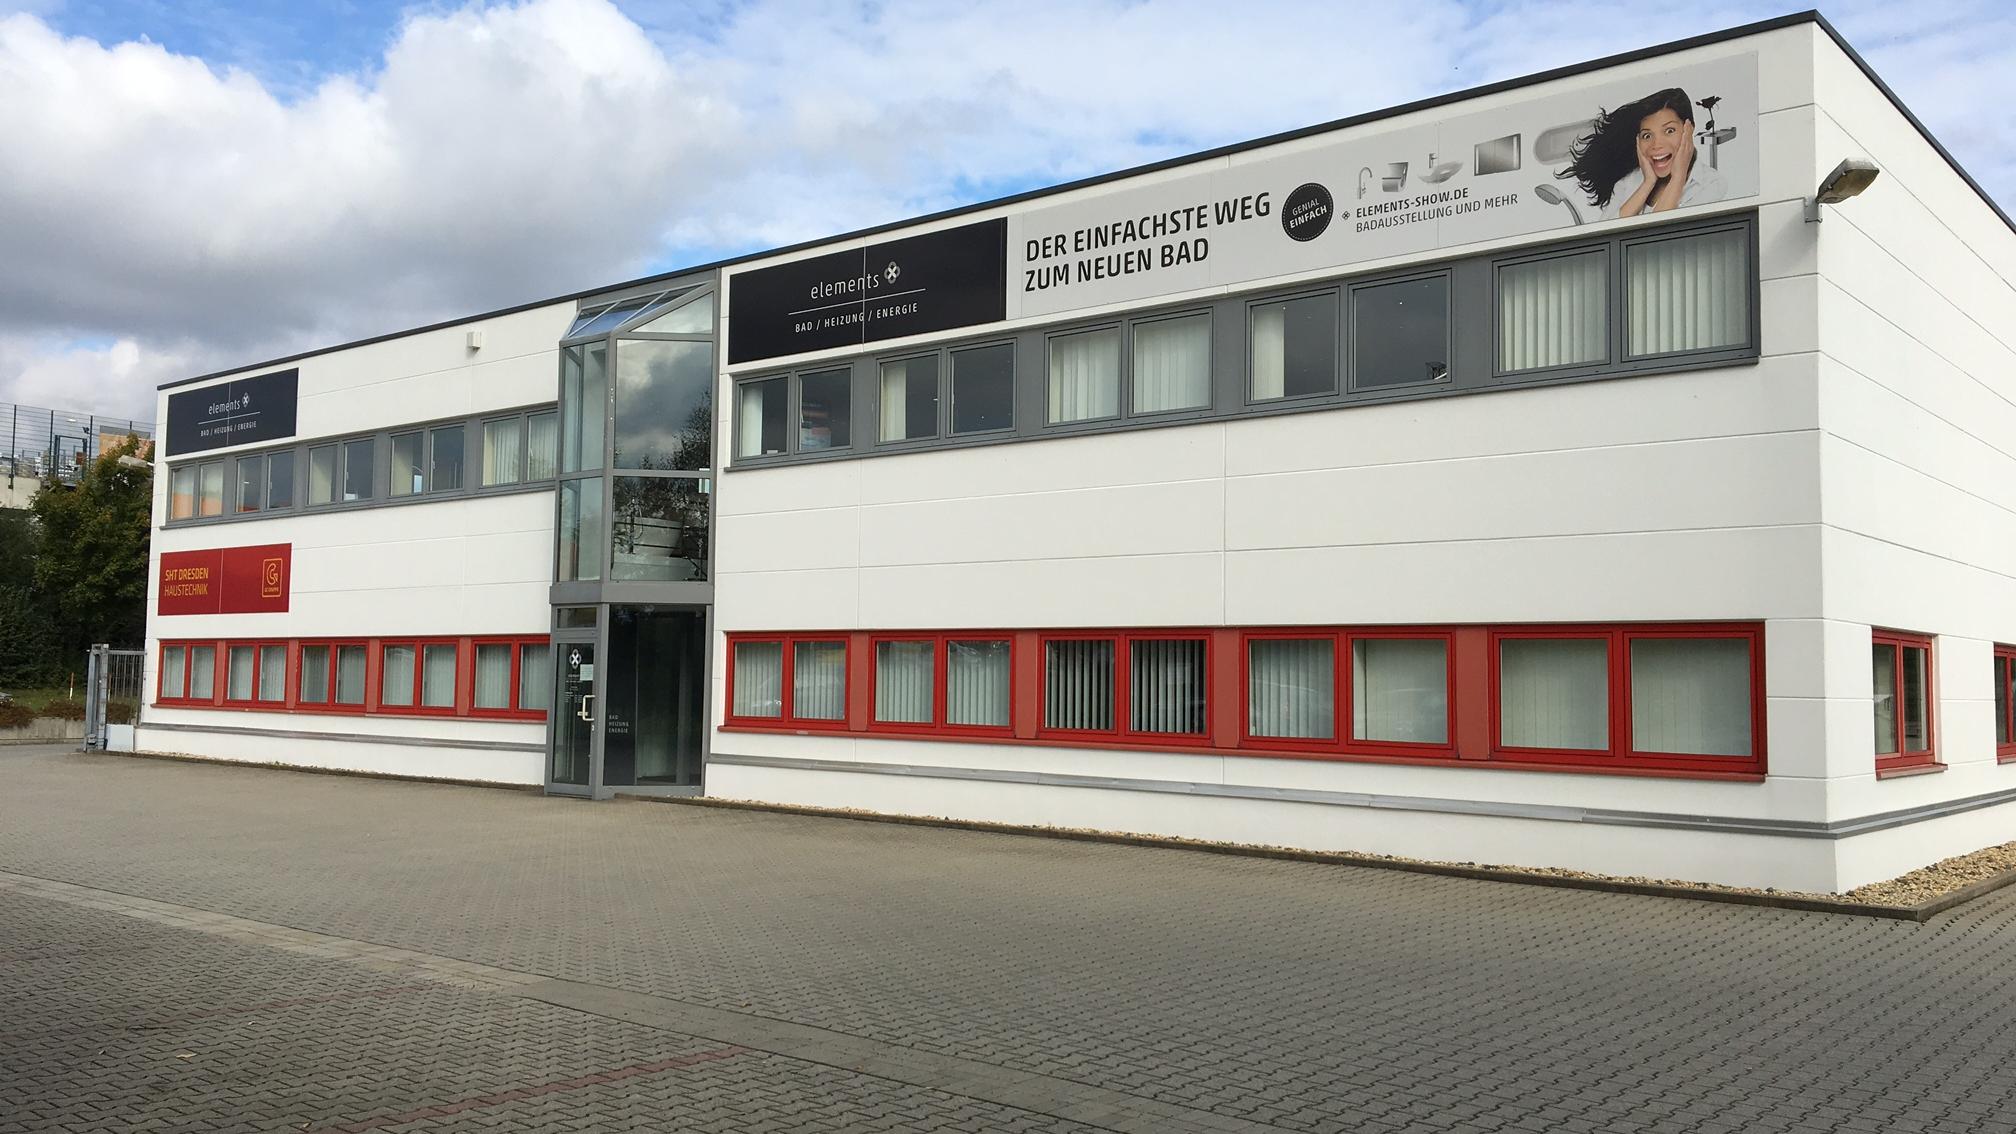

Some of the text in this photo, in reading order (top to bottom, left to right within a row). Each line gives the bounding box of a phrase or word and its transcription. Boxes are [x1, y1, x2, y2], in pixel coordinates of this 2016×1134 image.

[1292, 198, 1320, 216] GENIAL
[1356, 187, 1468, 218] ELEMENTS-SHOW.DE
[1356, 193, 1518, 233] BADAUSSTELLUNG UND MEHR
[1026, 192, 1270, 262] DER EINFACHSTE WEG
[1289, 205, 1328, 229] EINFACH
[1025, 237, 1209, 292] ZUM NEUEN BAD
[811, 273, 879, 300] elements
[795, 321, 812, 333] BAD
[824, 312, 864, 328] HEIZUNG
[876, 302, 918, 319] ENERGIE
[208, 400, 240, 415] elements
[165, 567, 209, 581] SHT DRESDEN
[164, 583, 208, 597] HAUSTECHNIK
